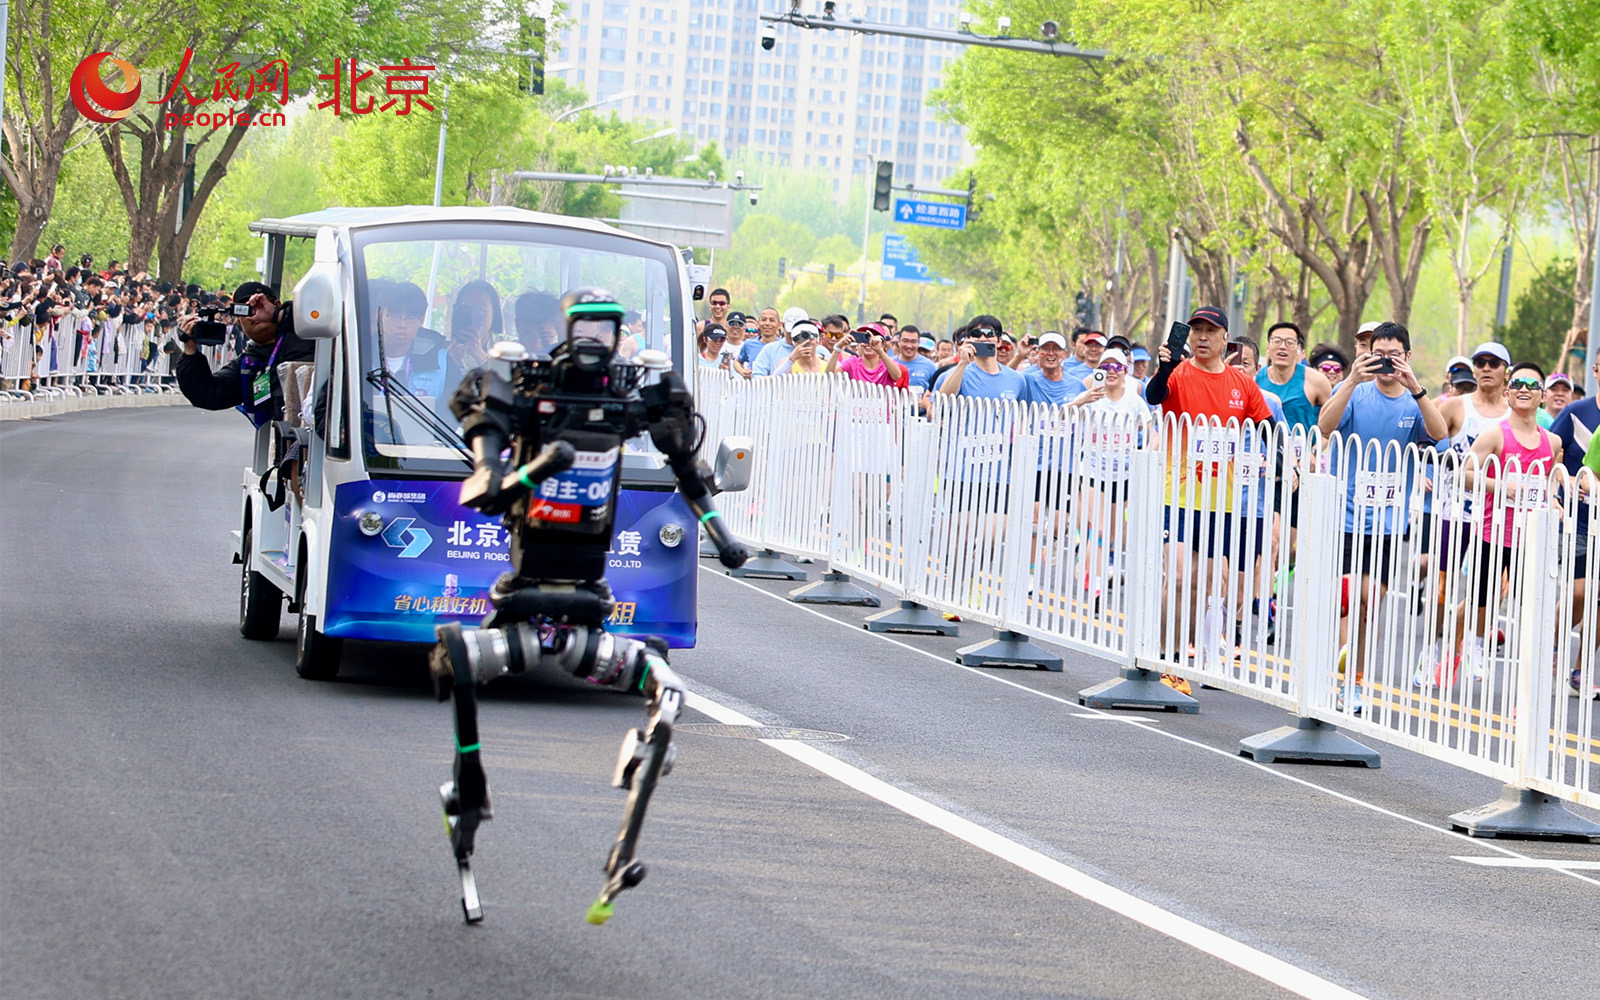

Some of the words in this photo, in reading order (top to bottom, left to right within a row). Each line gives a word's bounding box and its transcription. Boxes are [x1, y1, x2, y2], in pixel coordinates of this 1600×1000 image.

[446, 520, 512, 549] 北京
[446, 550, 481, 560] BEIJING
[484, 552, 511, 562] ROBO
[394, 595, 487, 615] 省心租好机
